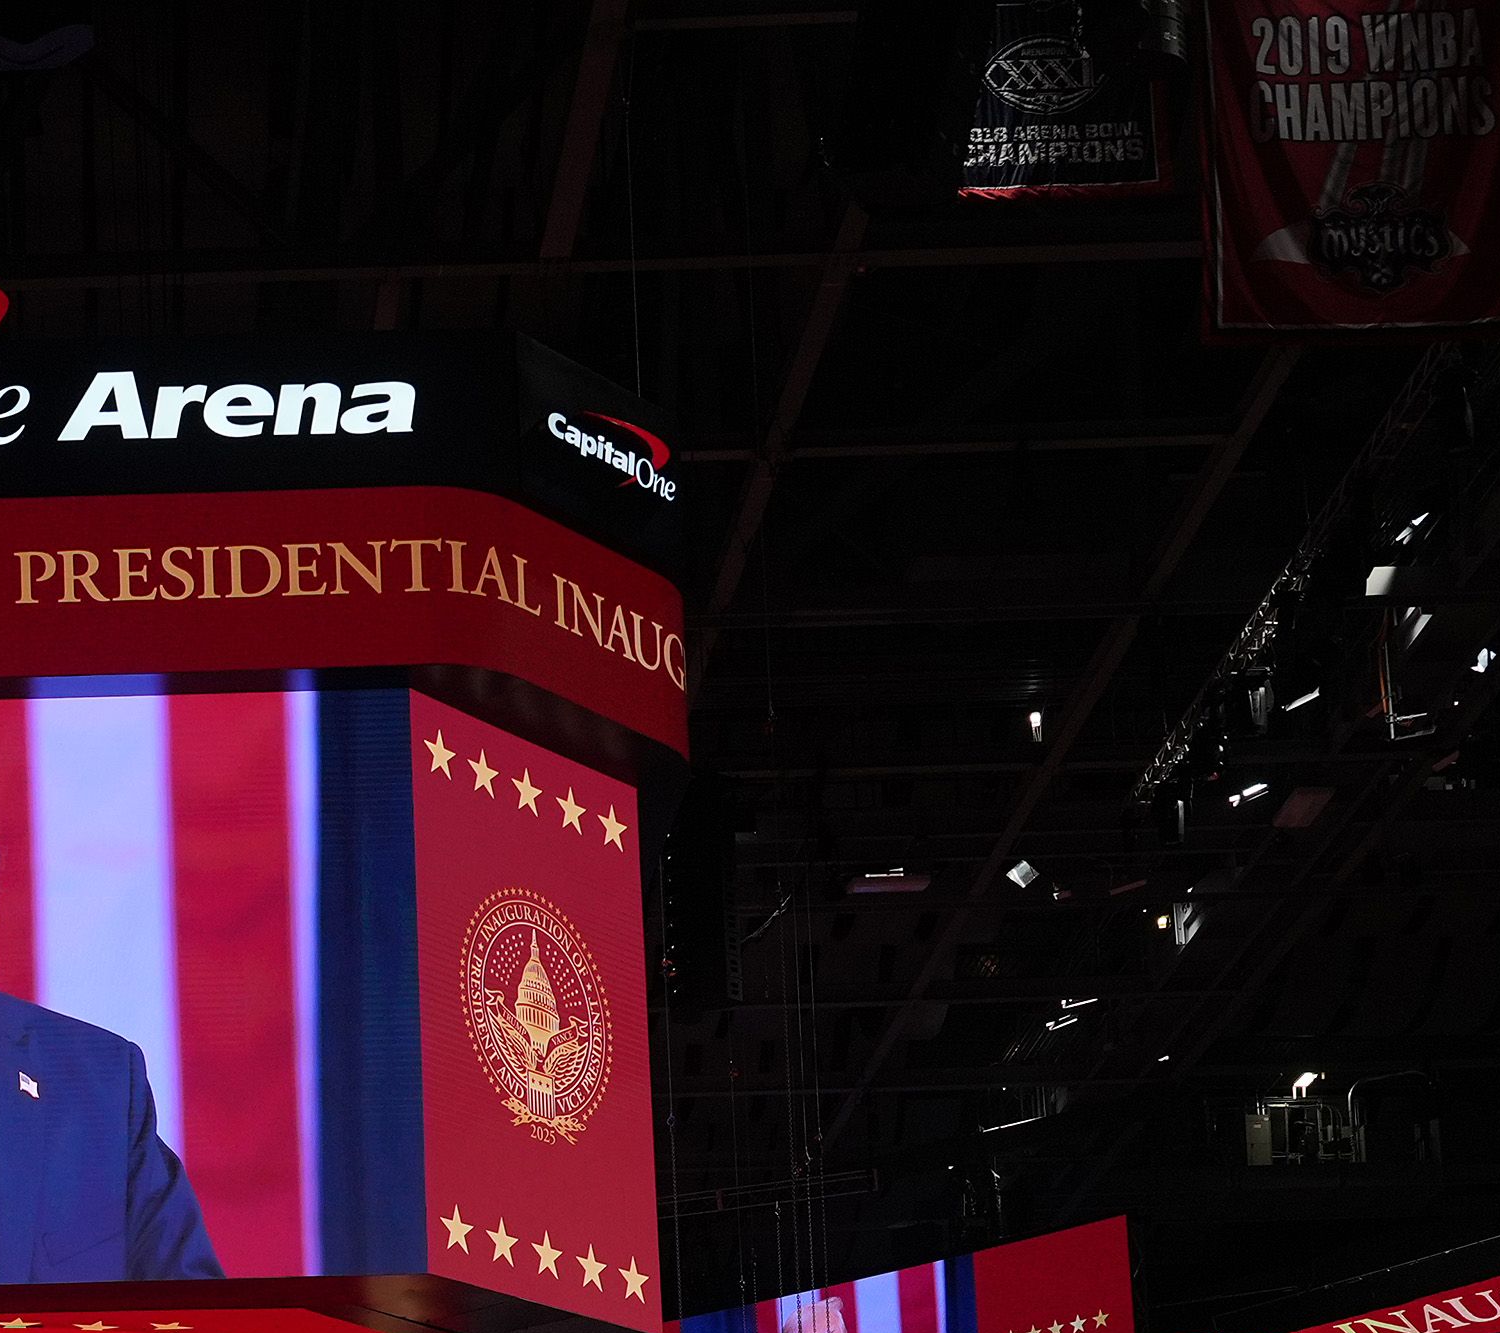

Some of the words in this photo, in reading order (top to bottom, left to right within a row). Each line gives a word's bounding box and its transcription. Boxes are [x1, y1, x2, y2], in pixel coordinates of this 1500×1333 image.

[1254, 15, 1350, 76] 2019
[1362, 8, 1482, 73] WNBA
[1014, 123, 1081, 142] ARENA
[1084, 121, 1144, 139] BOWL
[1250, 75, 1496, 144] CHAMPIONS
[58, 371, 416, 441] Arena
[14, 539, 541, 617] PRESIDENTIAL
[553, 573, 685, 692] INAUG
[480, 904, 572, 948] INAUGURATION
[572, 949, 588, 977] OF
[470, 953, 501, 1061] PRESIDENT
[496, 1065, 526, 1099] AND
[556, 1088, 586, 1114] VICE
[582, 997, 602, 1096] PRESIDENT
[530, 1124, 556, 1145] 2025
